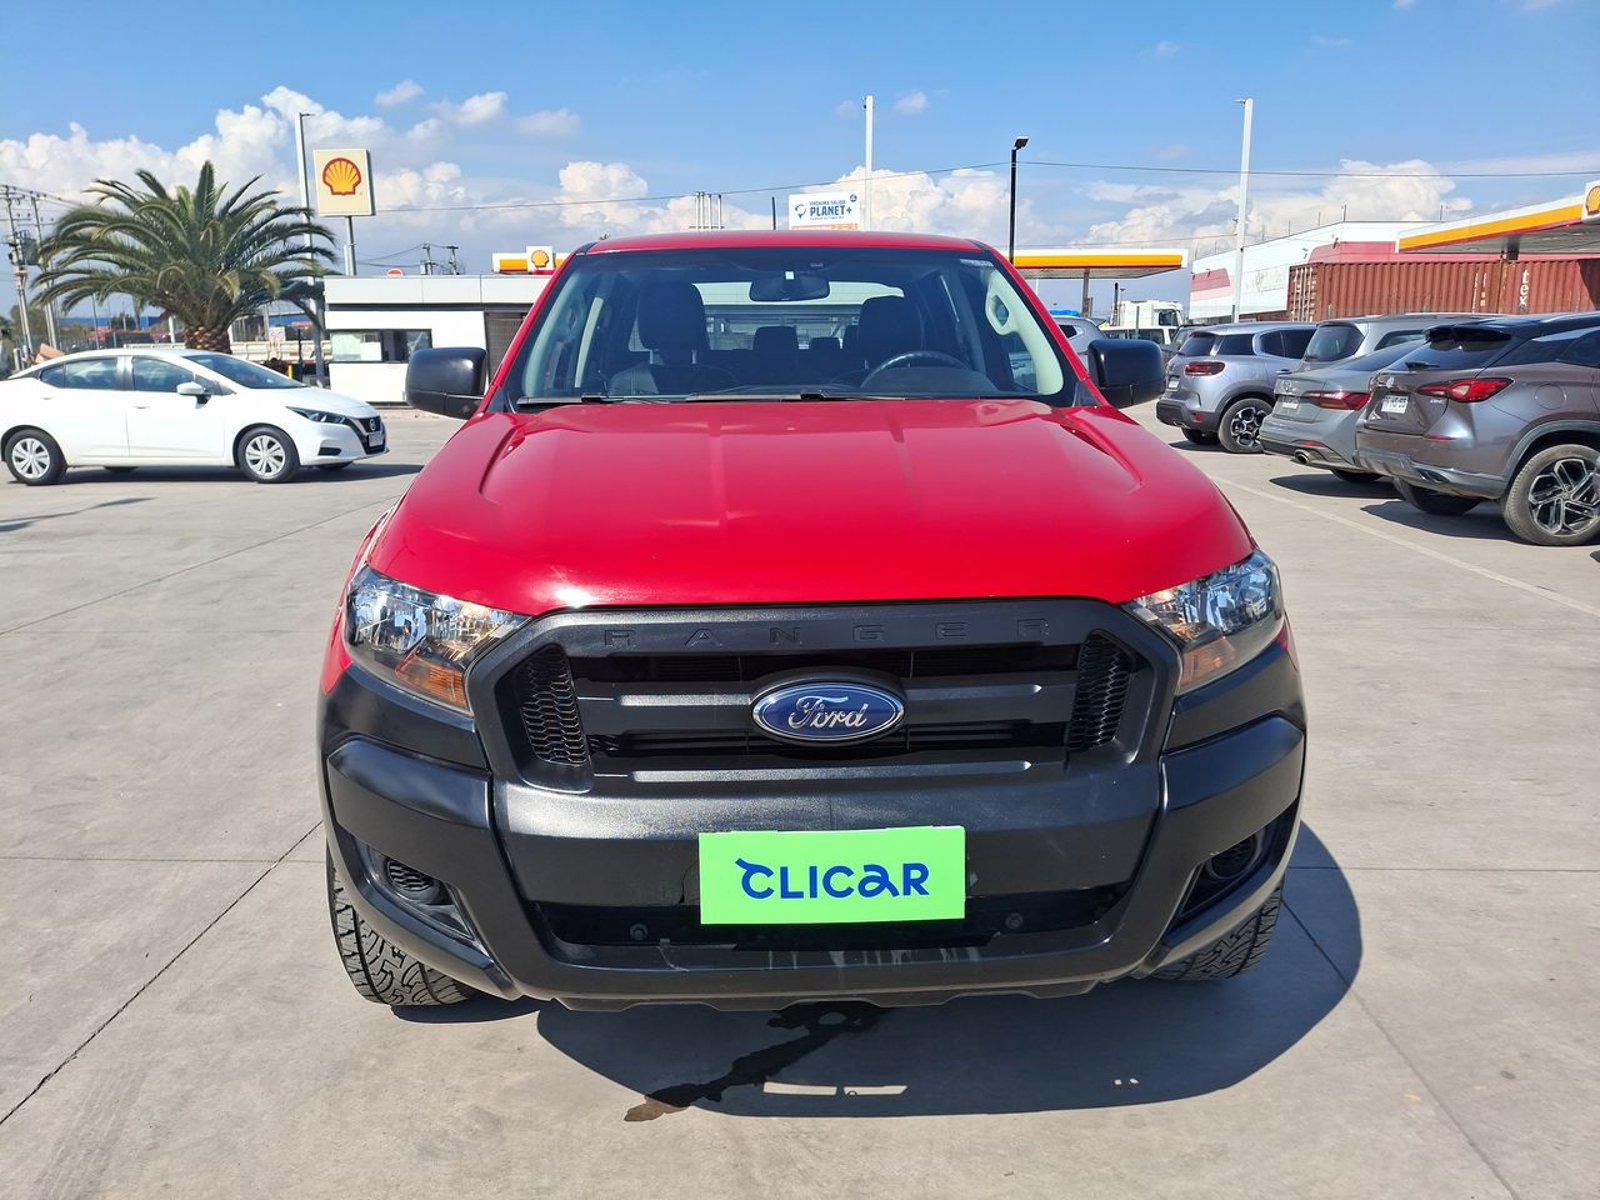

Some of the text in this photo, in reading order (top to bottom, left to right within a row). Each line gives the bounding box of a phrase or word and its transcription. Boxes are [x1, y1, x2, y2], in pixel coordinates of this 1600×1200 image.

[810, 205, 852, 217] PLANET+
[604, 618, 1050, 648] RANGER
[788, 695, 869, 729] Ford
